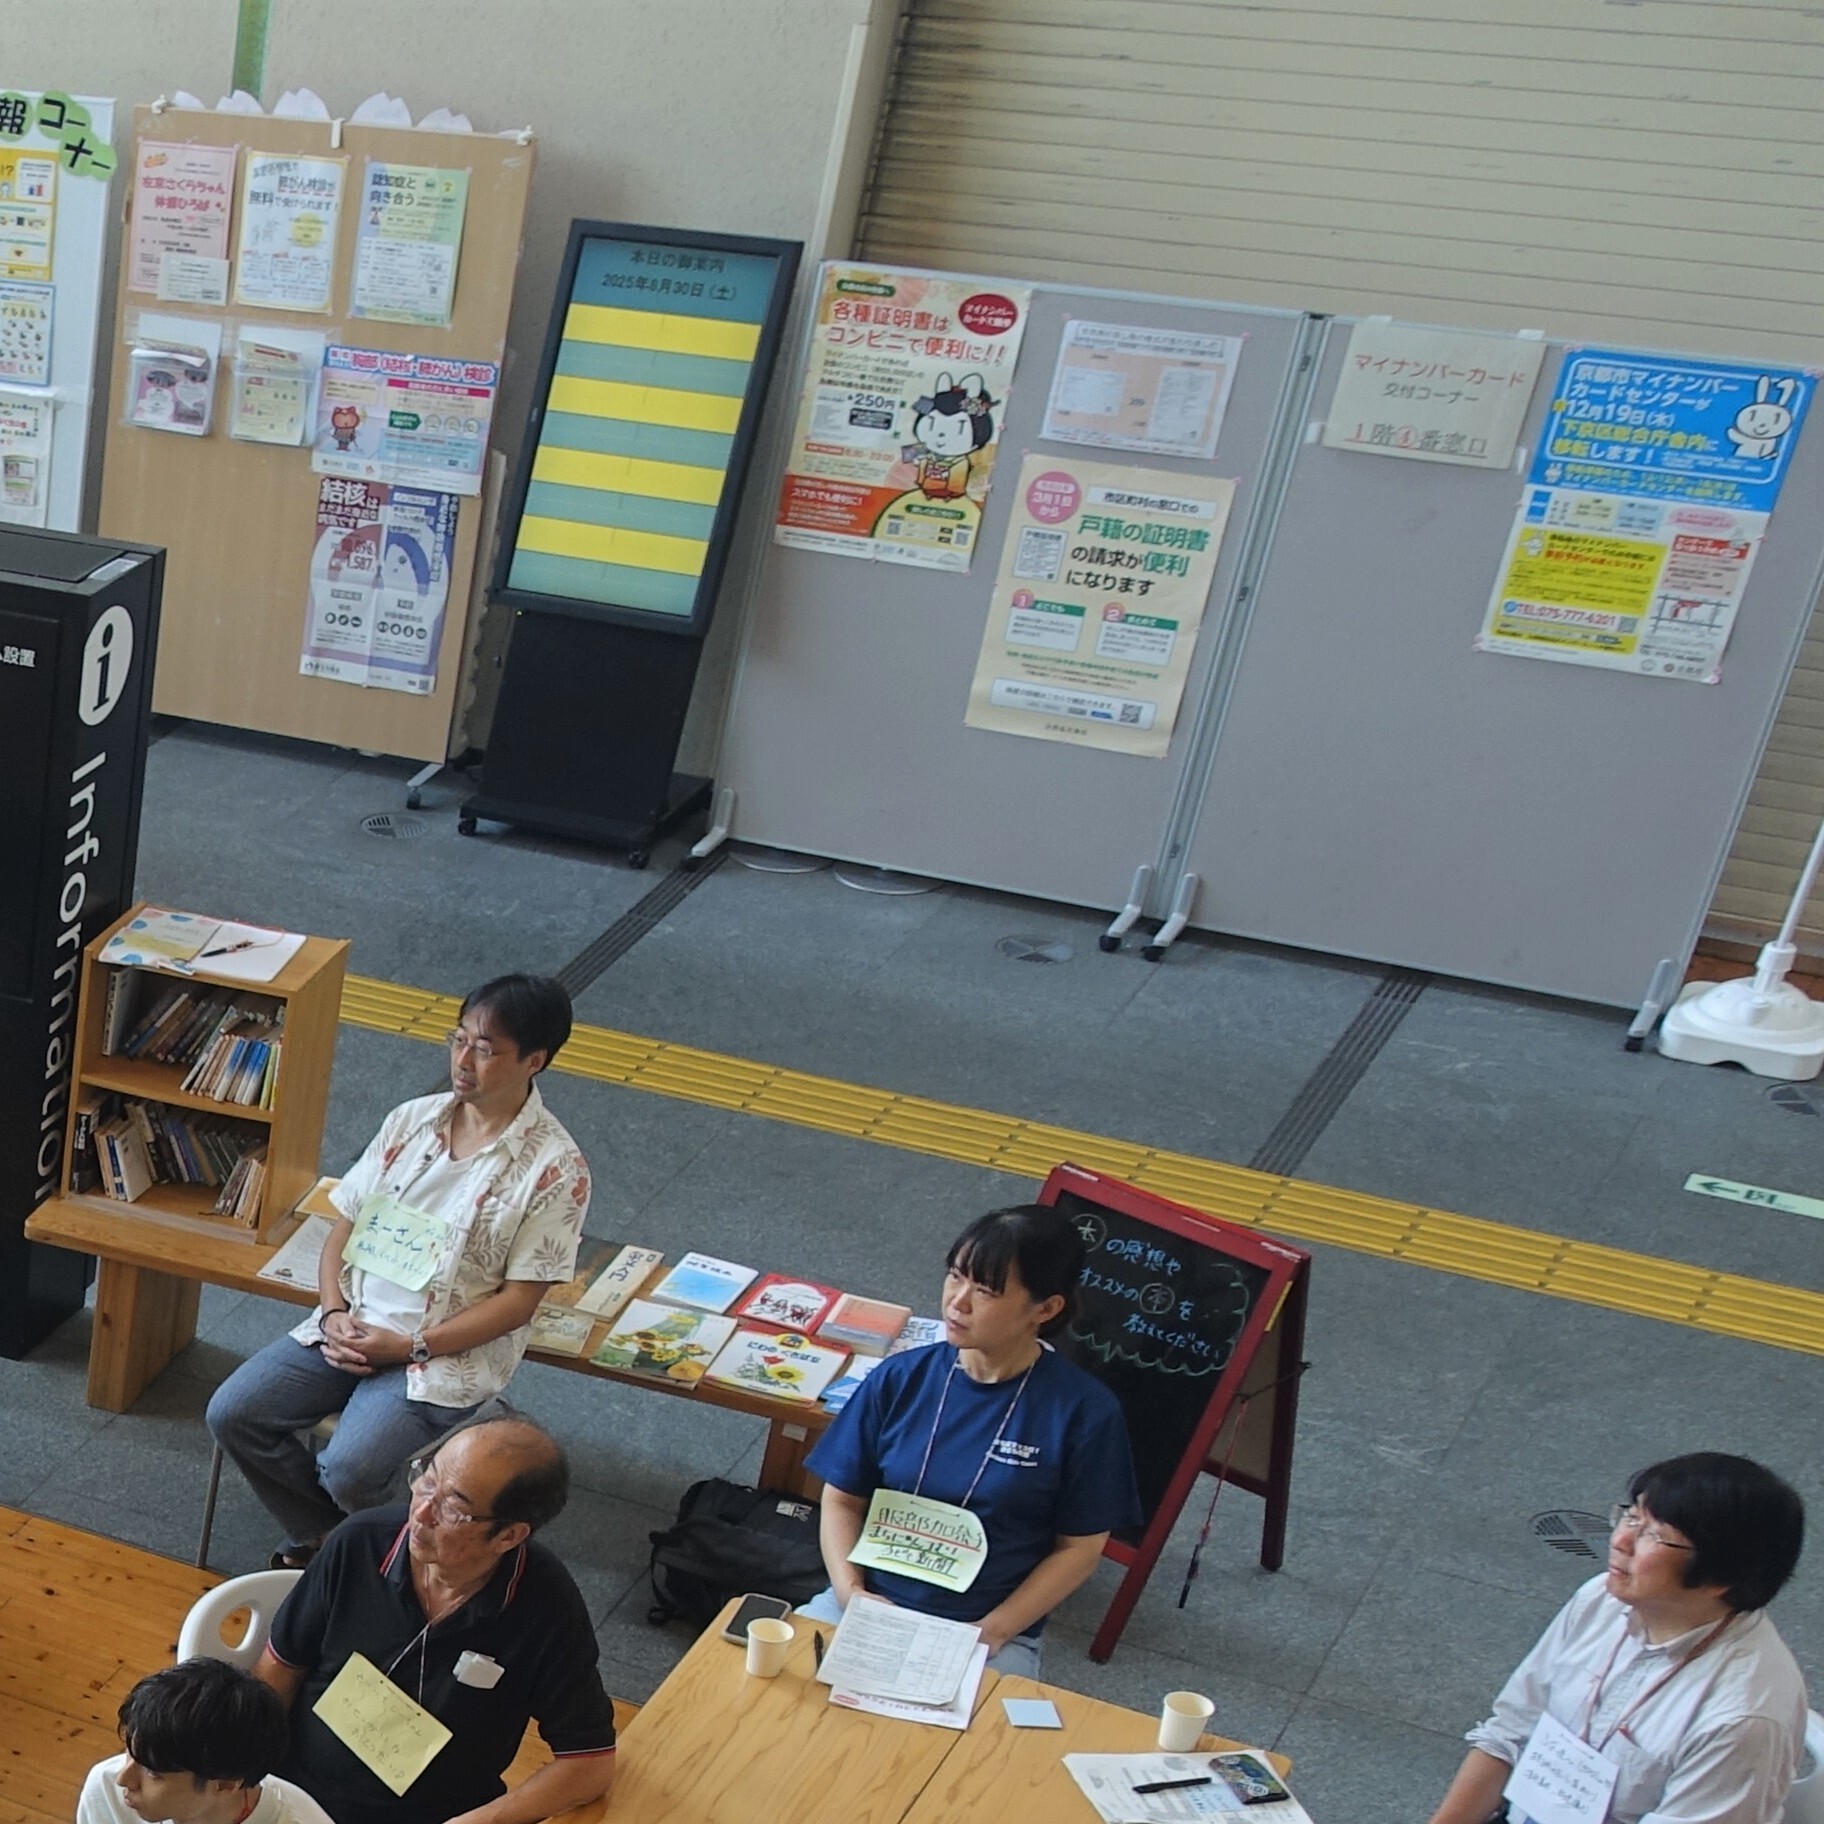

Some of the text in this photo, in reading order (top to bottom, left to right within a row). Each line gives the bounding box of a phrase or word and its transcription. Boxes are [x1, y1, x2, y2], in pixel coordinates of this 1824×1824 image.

[631, 250, 726, 273] 本日の御案内
[834, 300, 951, 331] 各種証明書は
[1355, 354, 1525, 388] マイナンバーカード
[1575, 365, 1740, 392] 京都市マイナンバー
[1383, 382, 1481, 404] 交付コーナー
[1570, 384, 1712, 411] カードセンターが
[1562, 420, 1719, 451] 下京区総合庁舎内に
[321, 479, 380, 509] 結核は
[1032, 491, 1072, 507] 3月1日
[1104, 491, 1200, 514] 市区町村の窓口での
[1038, 505, 1060, 517] から
[1077, 514, 1211, 552] 戸籍の証明書
[1071, 546, 1190, 577] の請求が便利
[1066, 570, 1156, 596] になります
[368, 1214, 423, 1252] まーさん
[1123, 1313, 1220, 1361] 教えてください
